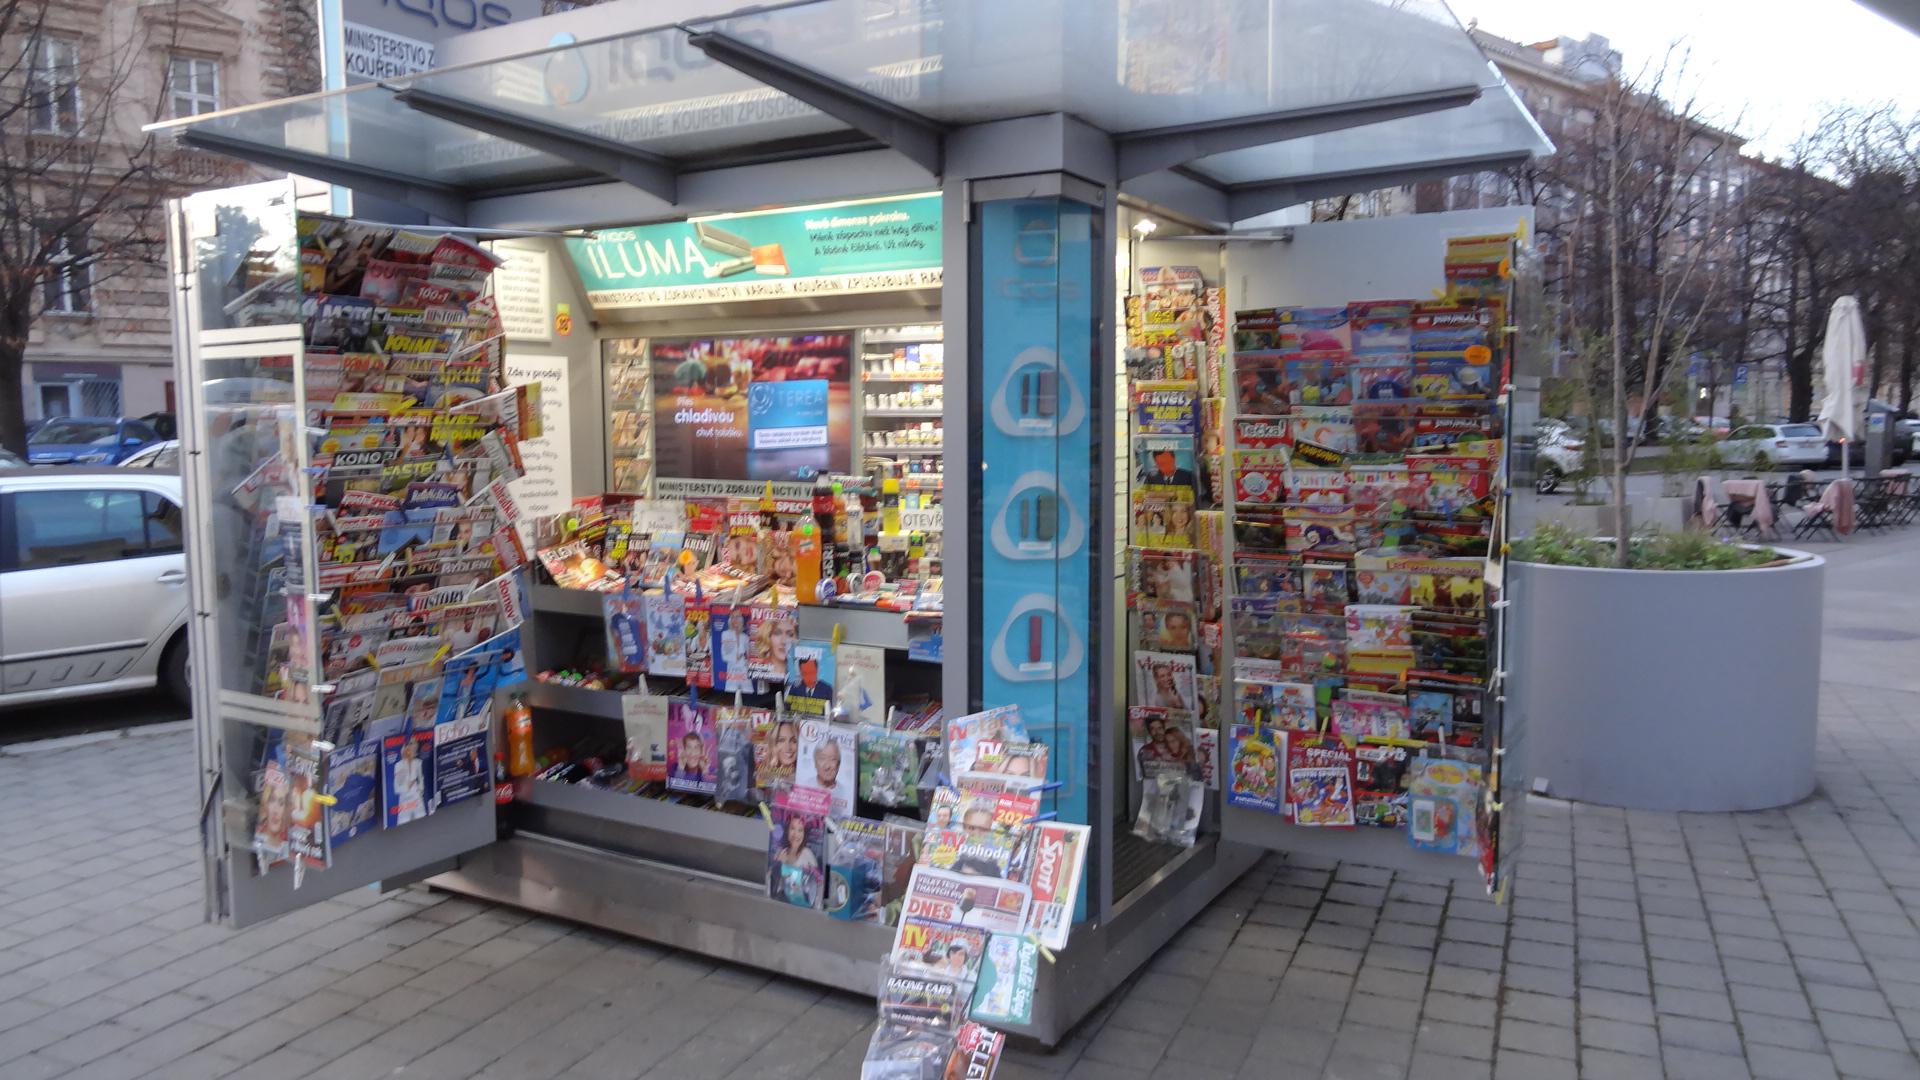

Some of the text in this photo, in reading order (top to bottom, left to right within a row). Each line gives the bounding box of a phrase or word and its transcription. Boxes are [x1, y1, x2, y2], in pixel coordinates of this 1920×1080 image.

[586, 236, 710, 279] ILUMA
[674, 410, 735, 425] chladivou
[726, 483, 802, 498] ZDRAVONICTVÍ
[499, 579, 515, 620] domov
[958, 843, 1010, 858] pohoda
[907, 899, 954, 920] DNES
[887, 977, 924, 991] RACING
